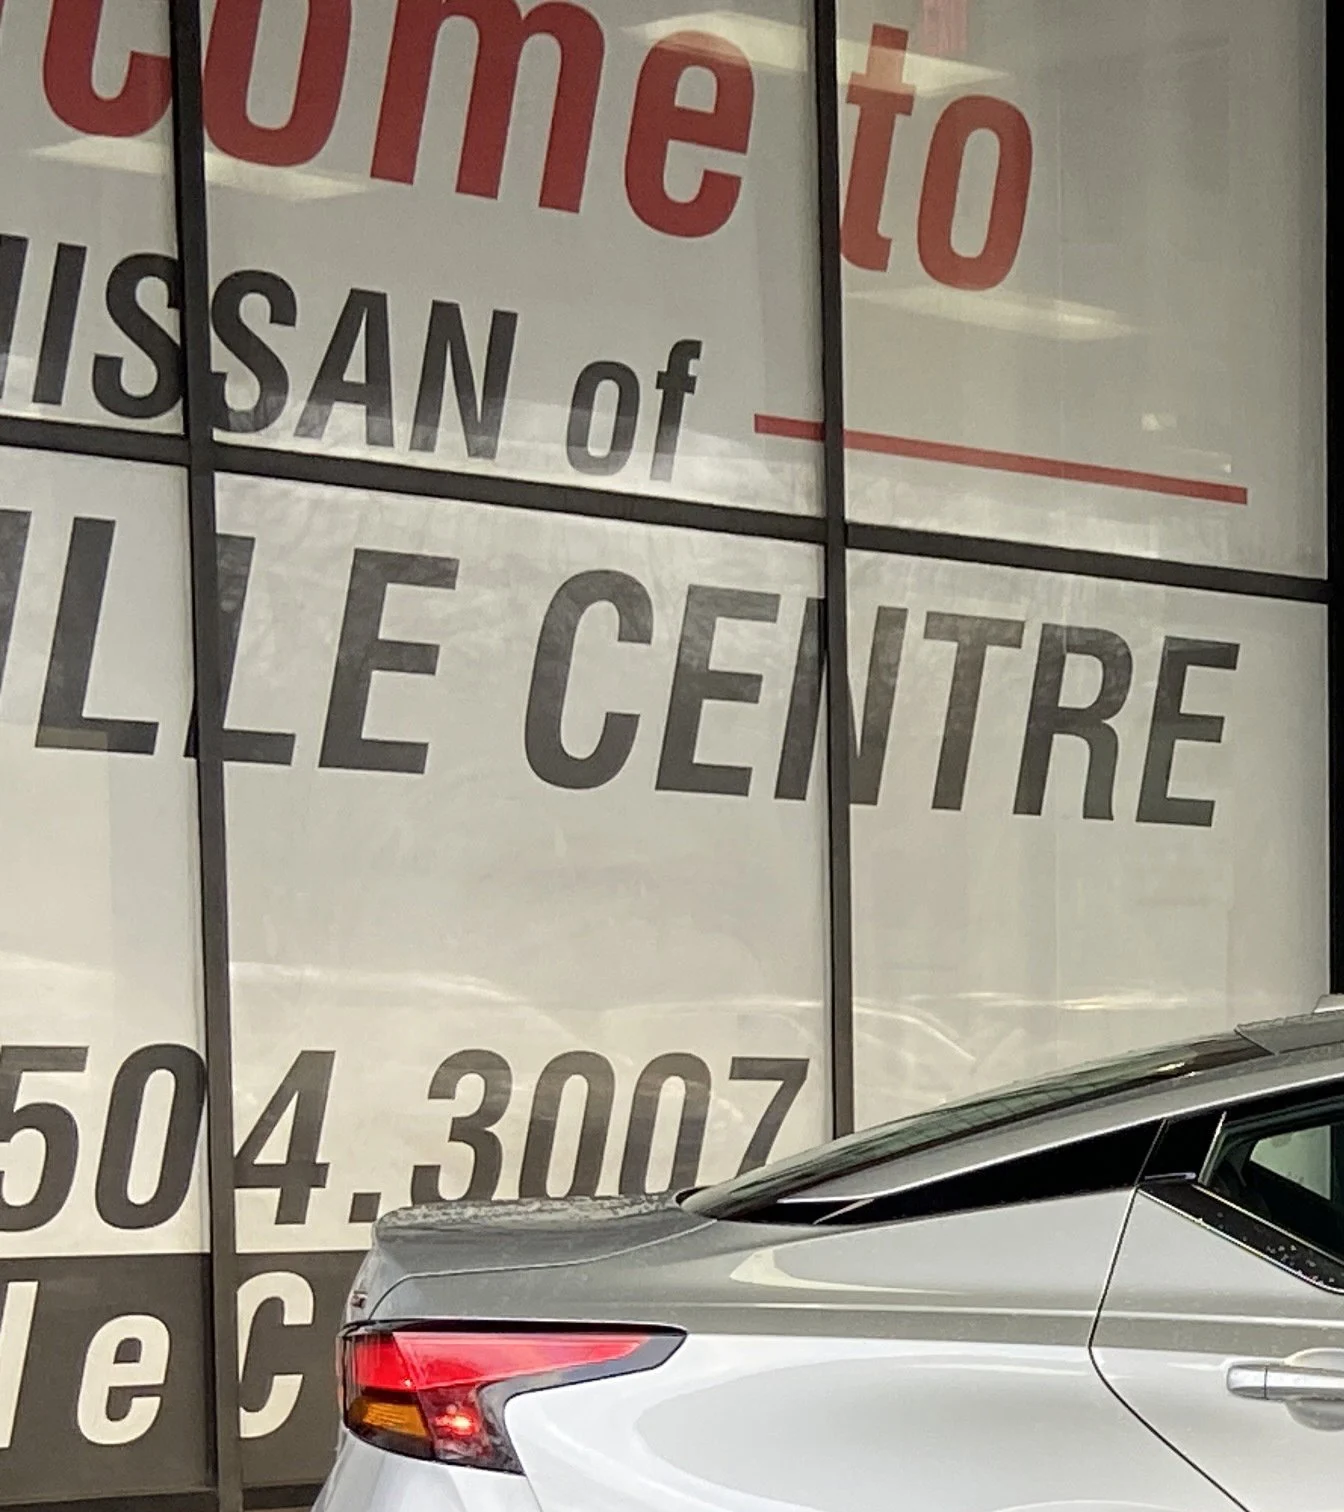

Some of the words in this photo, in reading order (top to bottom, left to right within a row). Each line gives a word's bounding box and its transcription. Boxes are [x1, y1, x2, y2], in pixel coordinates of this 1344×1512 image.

[841, 23, 1034, 292] to
[565, 338, 703, 482] of
[524, 569, 1241, 828] CENTRE
